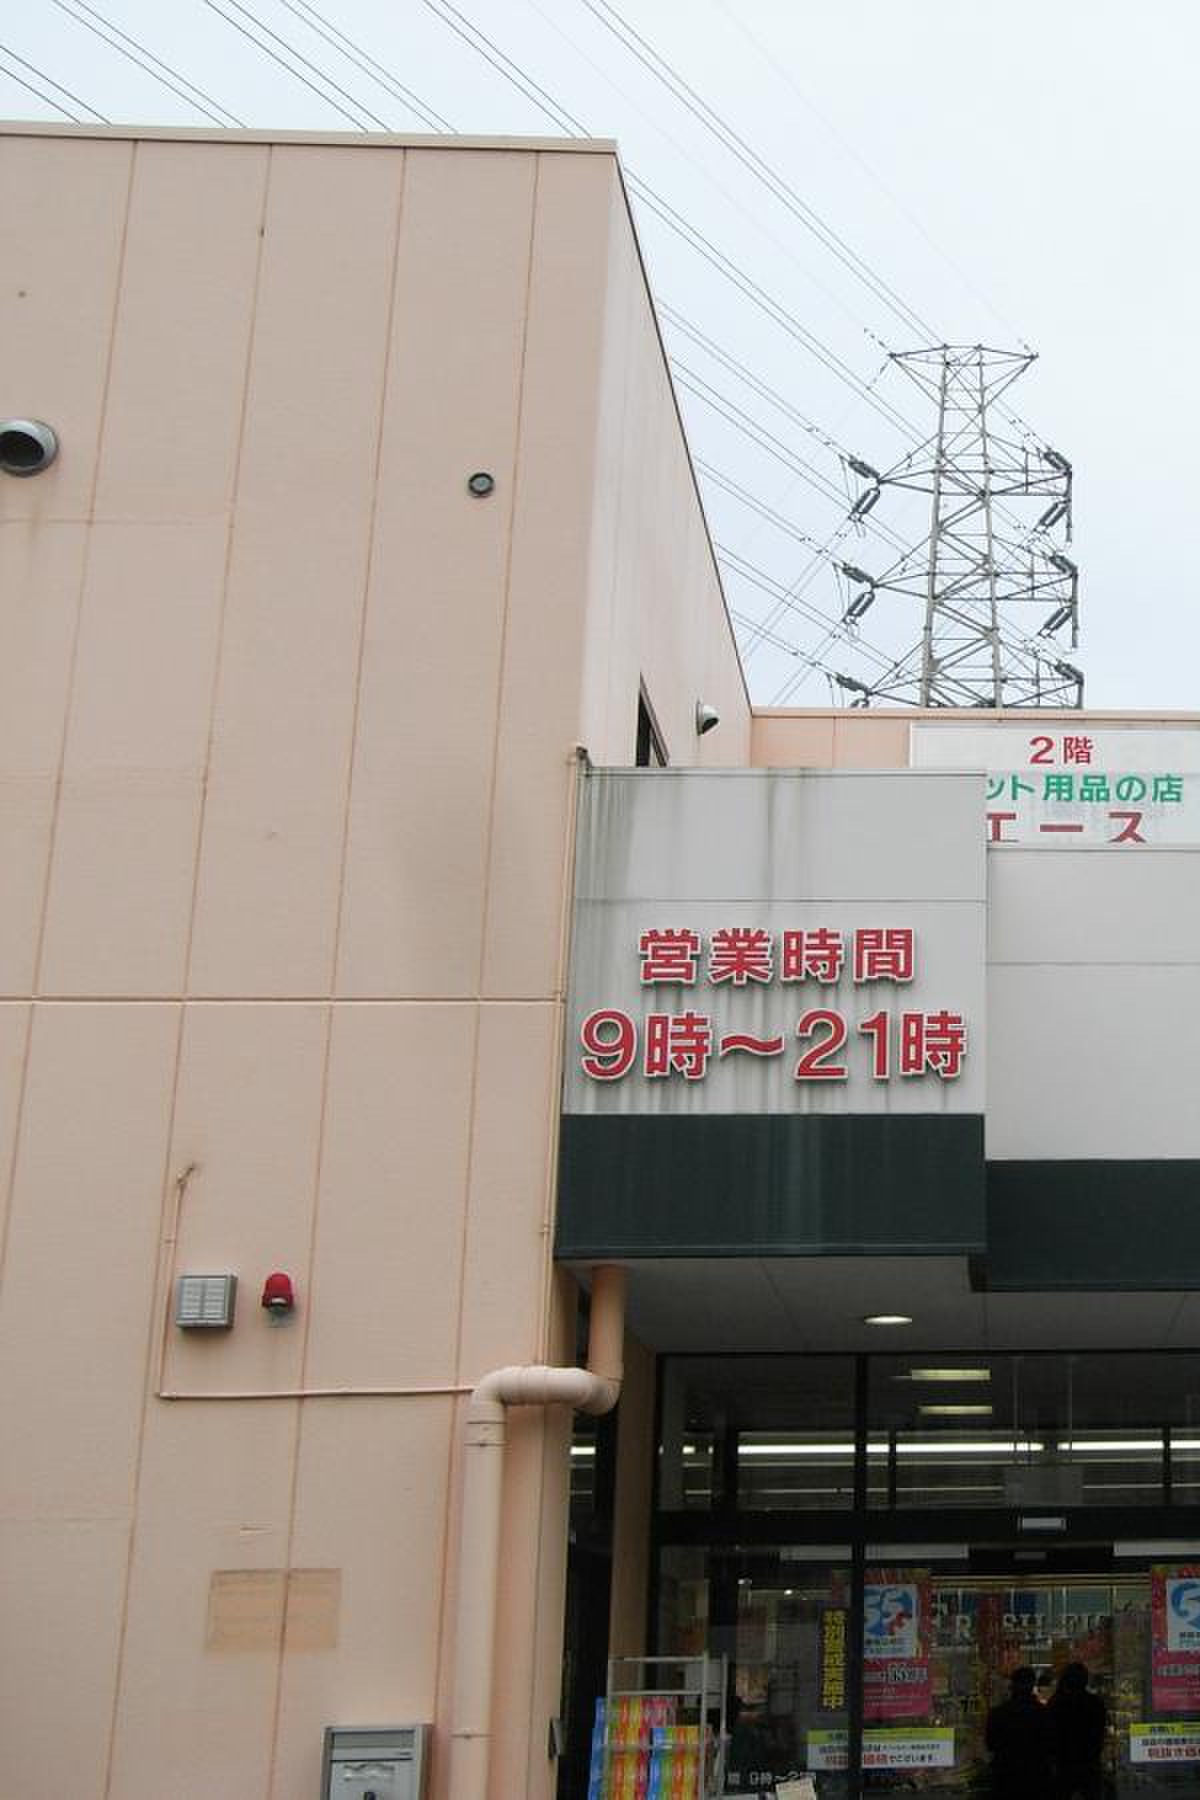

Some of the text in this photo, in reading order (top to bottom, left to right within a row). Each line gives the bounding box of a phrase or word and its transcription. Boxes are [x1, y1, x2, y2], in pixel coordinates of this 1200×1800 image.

[1029, 735, 1094, 765] 2階
[639, 927, 915, 985] 営業時間
